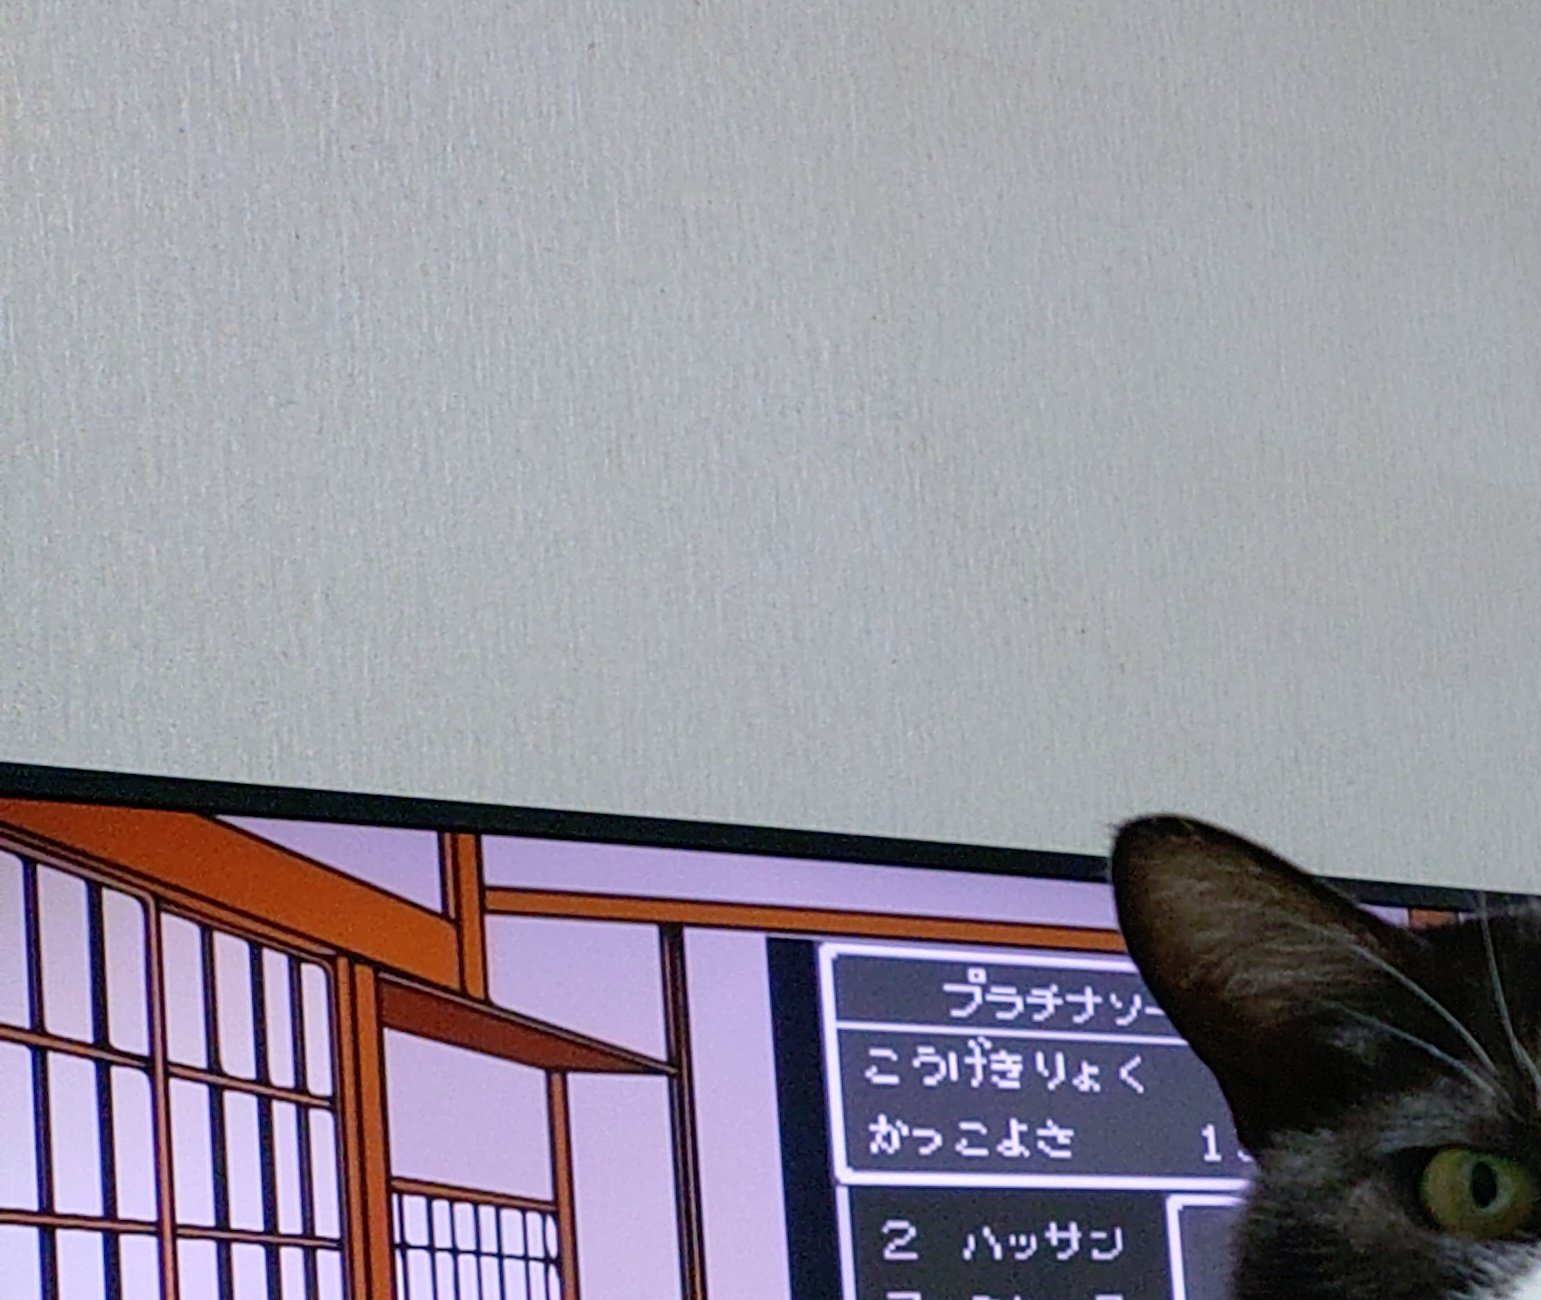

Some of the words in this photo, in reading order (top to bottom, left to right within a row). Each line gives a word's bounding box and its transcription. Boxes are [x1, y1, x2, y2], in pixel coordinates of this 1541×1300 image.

[866, 1037, 1144, 1093] こうげきりょく
[869, 1114, 1074, 1158] かっこよさ
[882, 1220, 919, 1260] 2
[962, 1222, 1124, 1260] ハッサン
